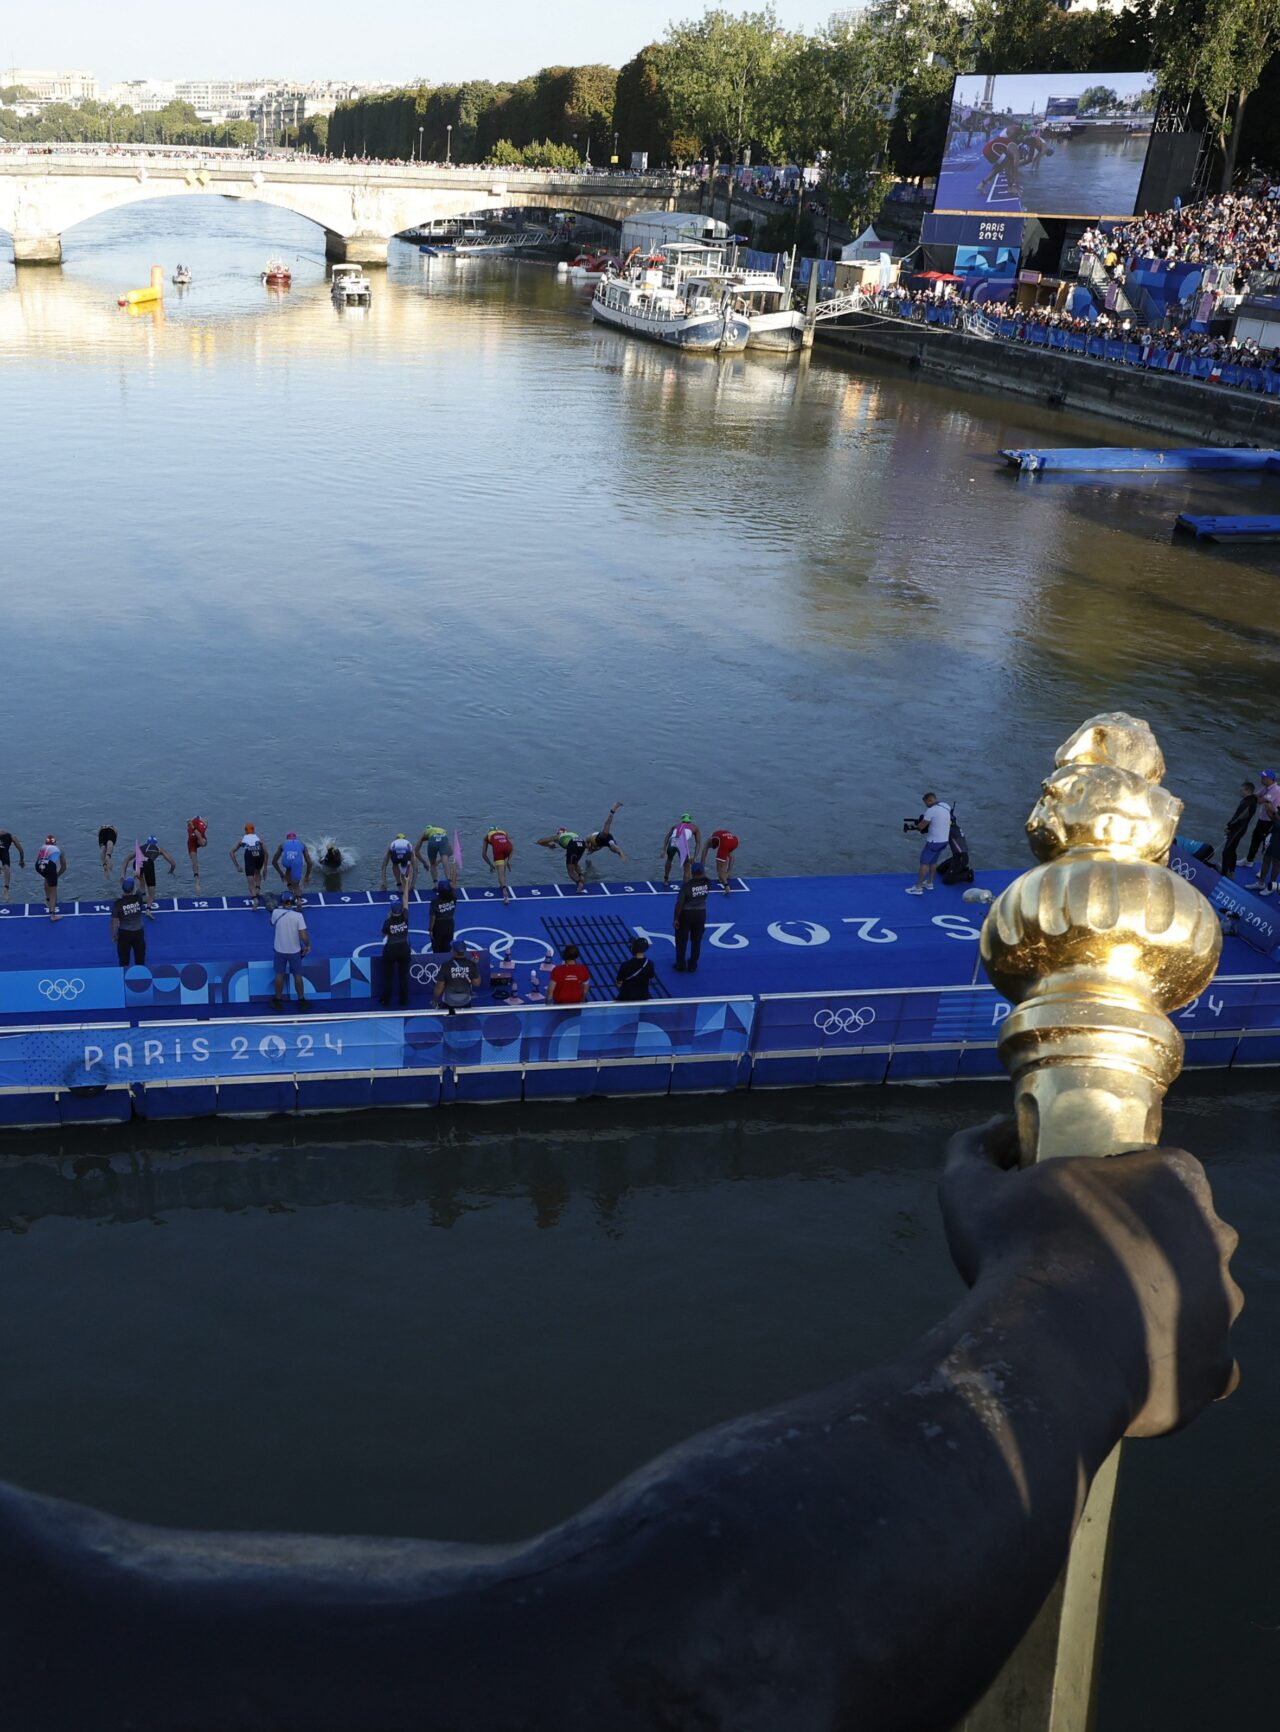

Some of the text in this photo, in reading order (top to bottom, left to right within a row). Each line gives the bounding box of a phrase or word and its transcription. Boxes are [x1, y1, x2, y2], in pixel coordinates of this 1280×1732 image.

[980, 222, 1005, 232] PARIS
[979, 231, 1004, 241] 2024
[691, 884, 708, 893] PARIS
[93, 904, 111, 912] 14
[1215, 890, 1275, 937] PARIS 2024
[451, 966, 470, 974] PARIS
[1179, 994, 1224, 1018] 24
[84, 1033, 343, 1072] PARIS 2024
